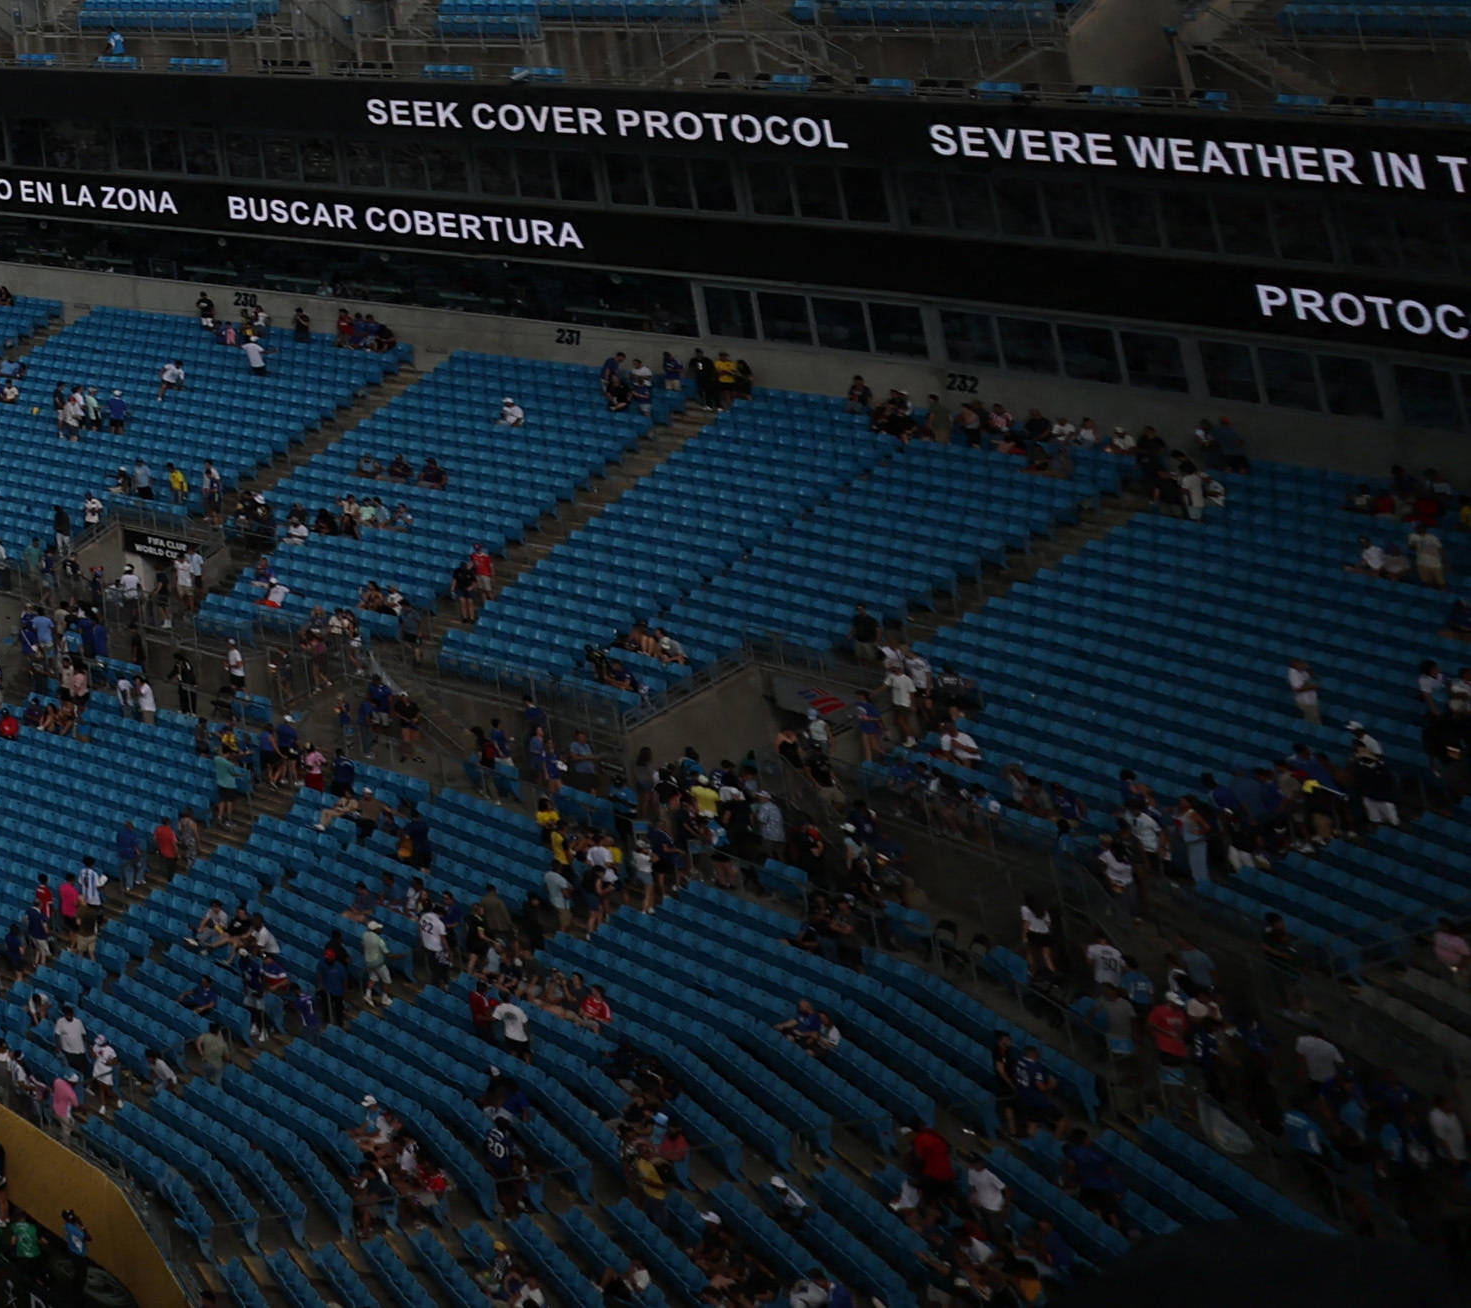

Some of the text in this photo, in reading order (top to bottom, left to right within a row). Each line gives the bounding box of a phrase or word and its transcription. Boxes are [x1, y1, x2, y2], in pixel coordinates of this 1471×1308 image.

[366, 98, 849, 149] SEEK COVER PROTOCOL
[929, 124, 1426, 190] SEVERE WEATHER IN
[19, 180, 54, 204] EN
[61, 183, 96, 208] LA
[100, 186, 179, 215] ZONA
[227, 195, 584, 249] BUSCAR COBERTURA
[234, 292, 257, 307] 230
[556, 329, 582, 345] 231
[946, 374, 979, 394] 232
